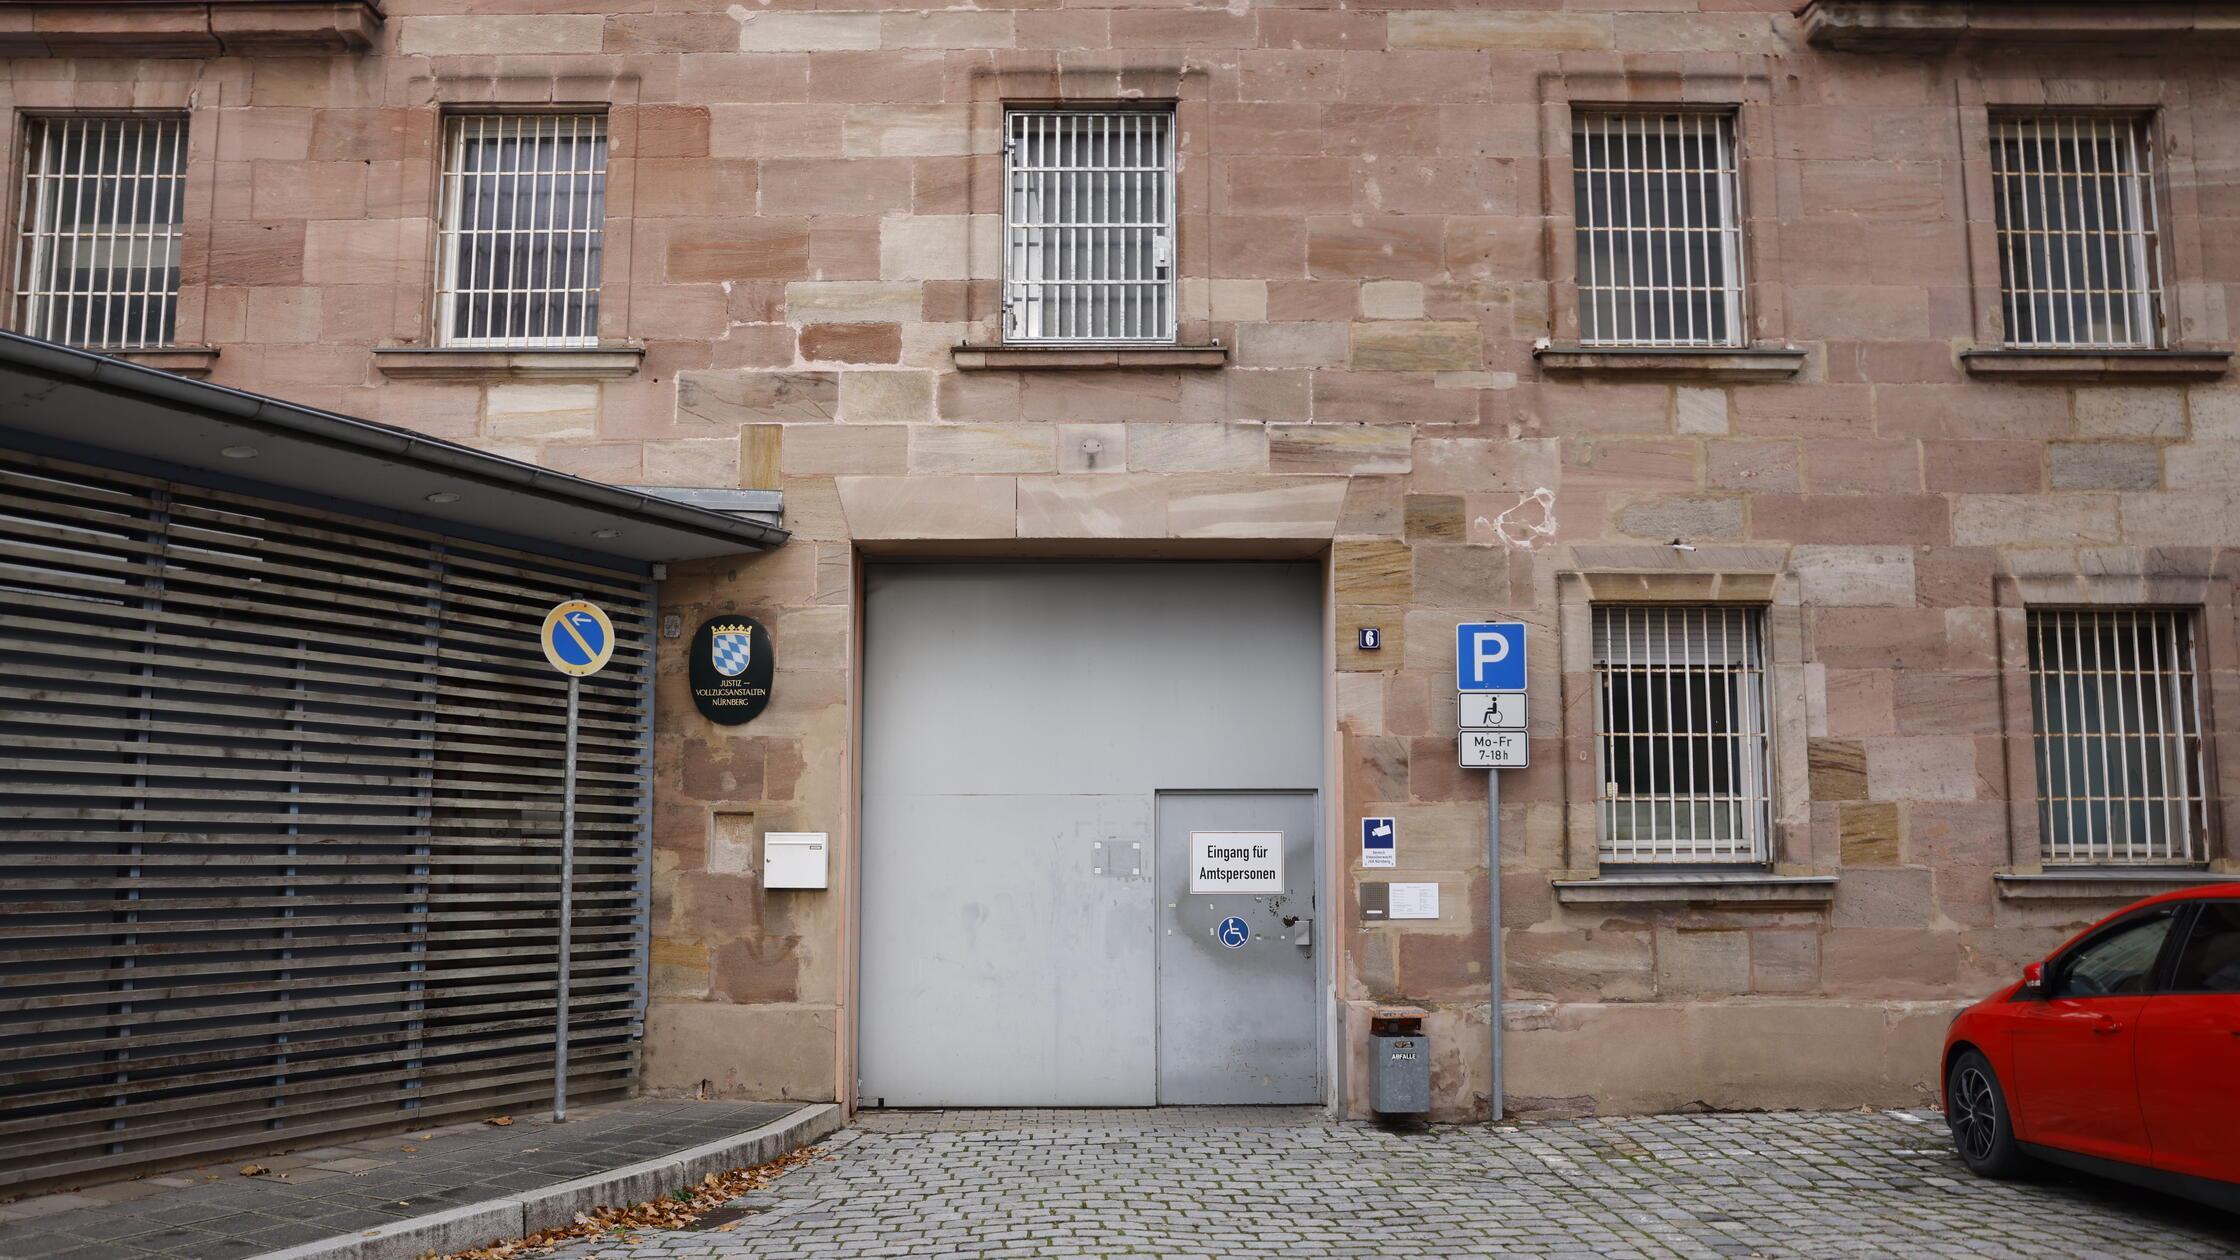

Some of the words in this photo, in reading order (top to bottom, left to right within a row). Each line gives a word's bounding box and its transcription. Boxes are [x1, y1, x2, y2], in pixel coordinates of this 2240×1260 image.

[1366, 630, 1374, 646] 6
[1473, 632, 1509, 682] P
[1474, 736, 1512, 747] Mo-Fr
[1208, 845, 1249, 861] Eingang
[1253, 845, 1268, 858] für
[1200, 867, 1276, 882] Amtspersonen
